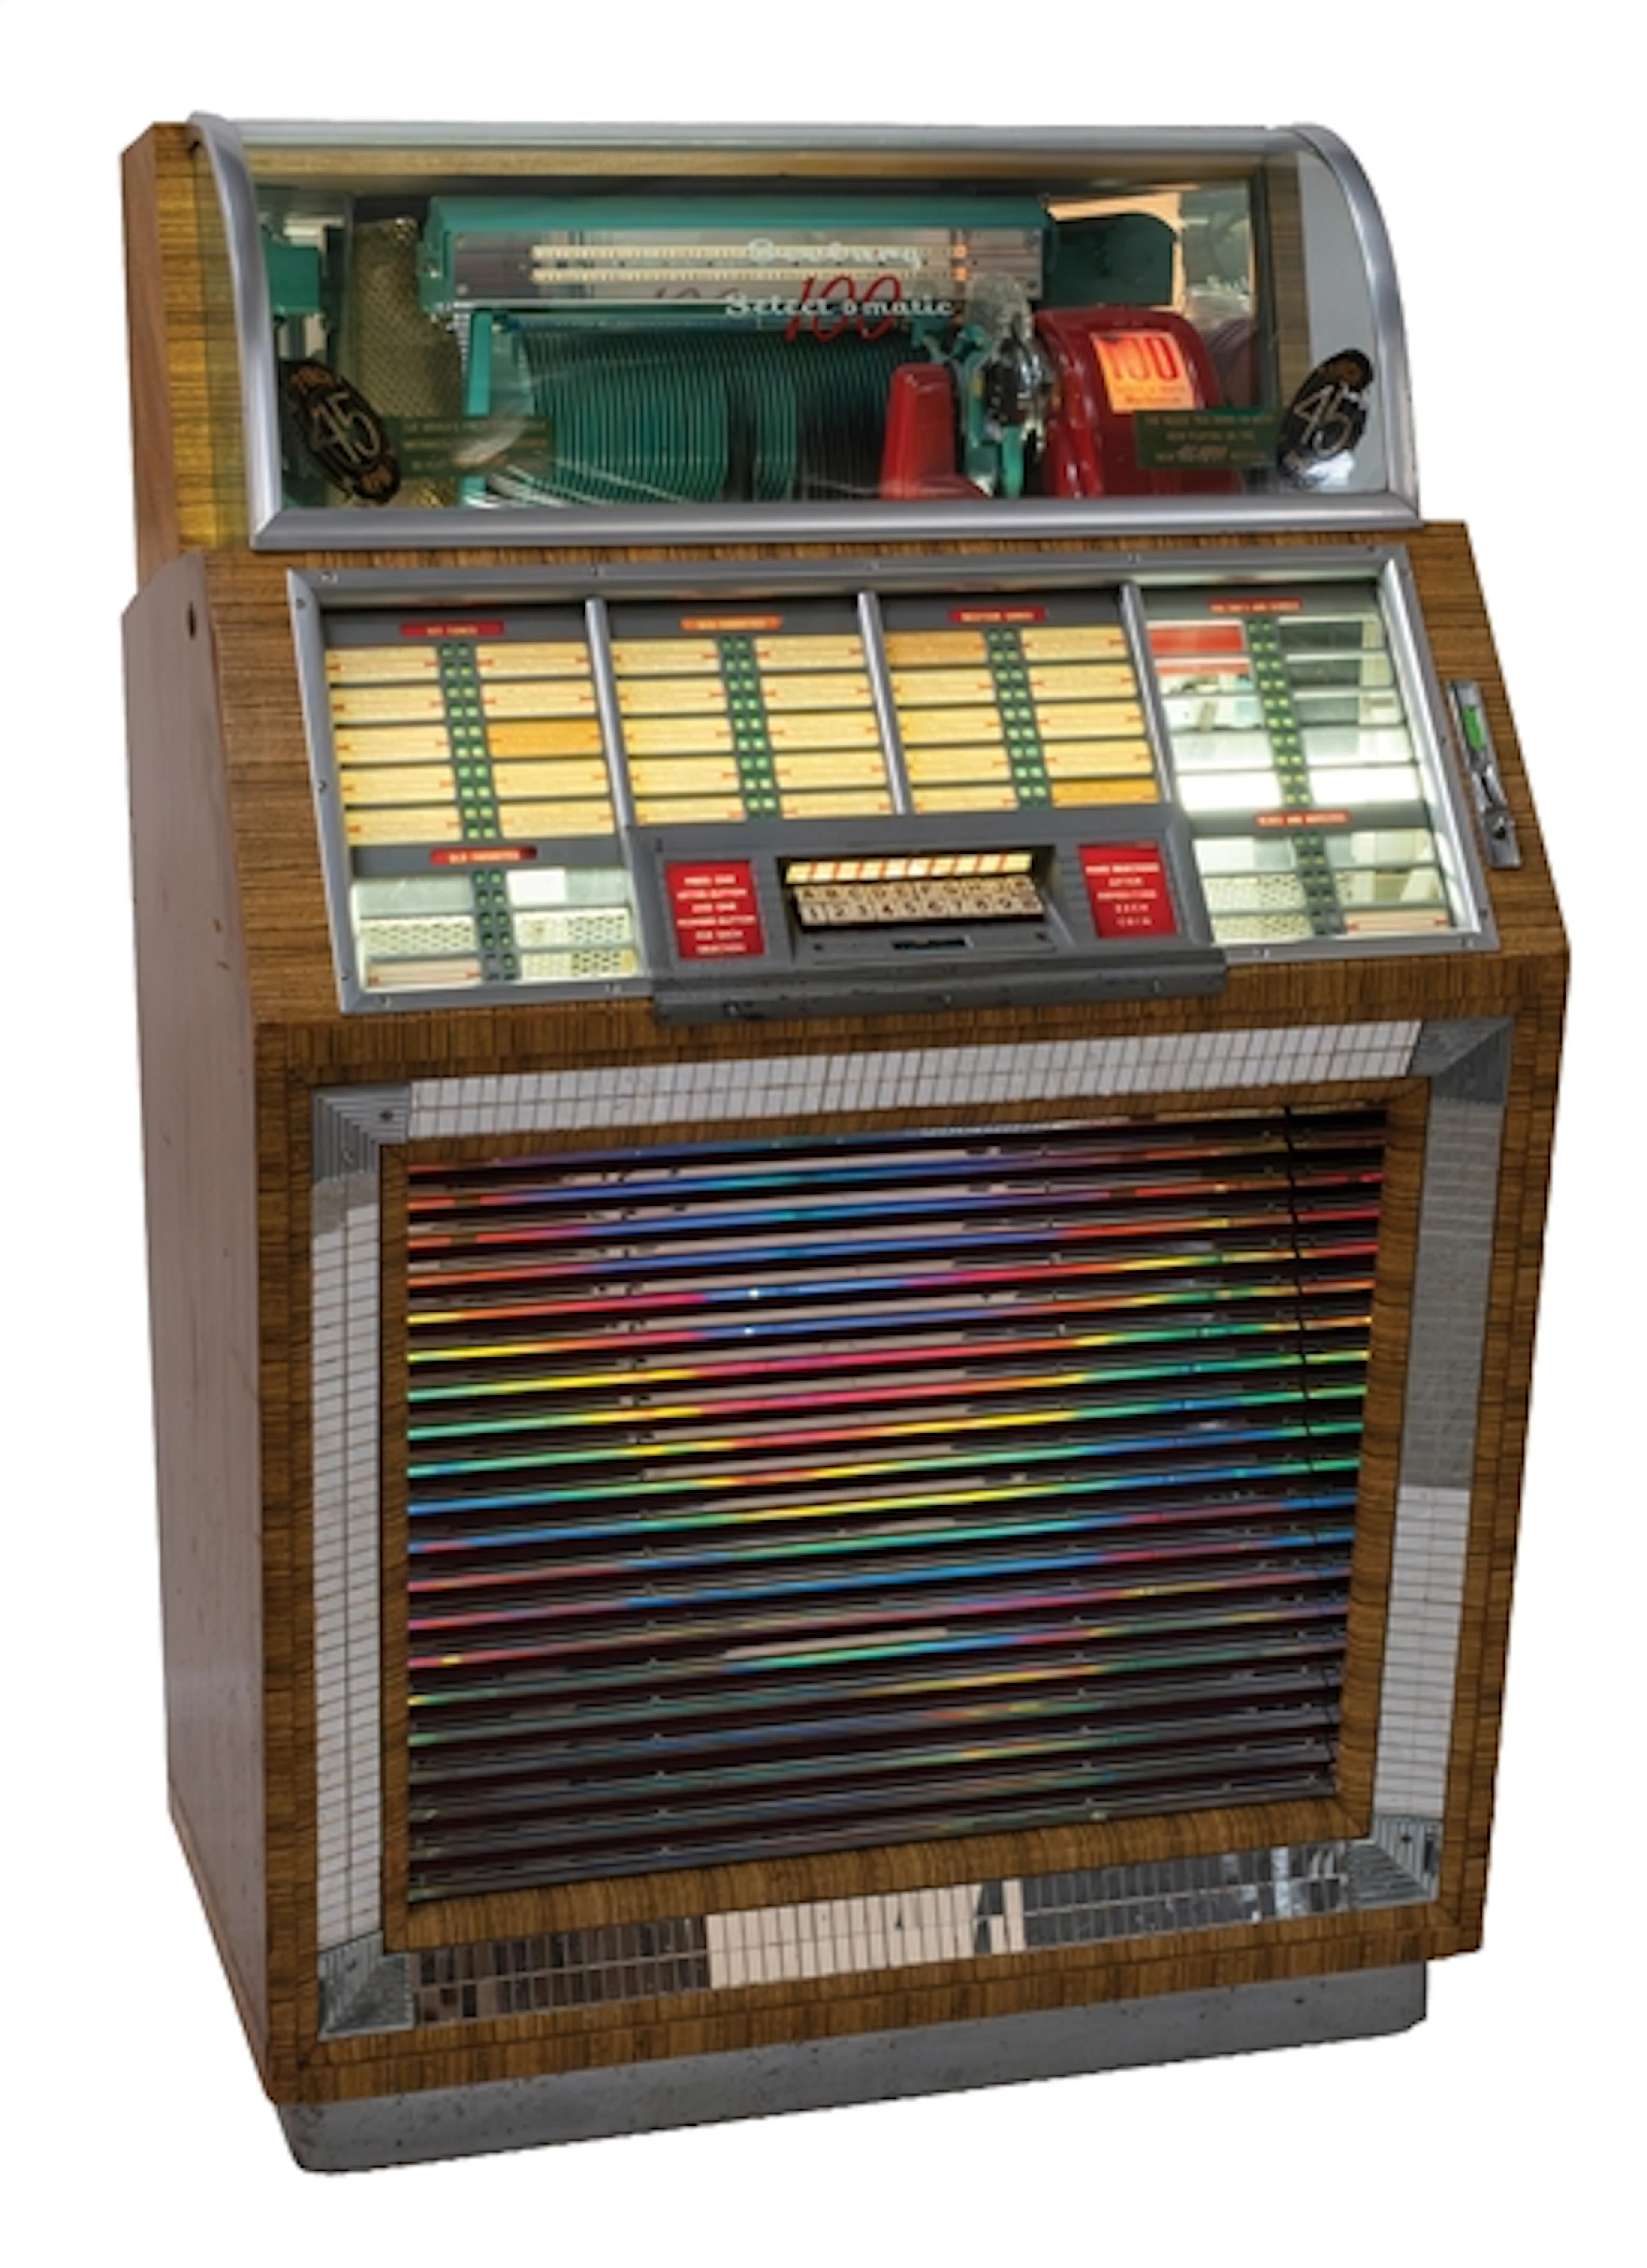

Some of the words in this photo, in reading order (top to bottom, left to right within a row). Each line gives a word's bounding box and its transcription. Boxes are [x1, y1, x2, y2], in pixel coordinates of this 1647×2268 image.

[785, 273, 903, 342] 100
[310, 391, 380, 464] 45
[1293, 384, 1359, 456] 45
